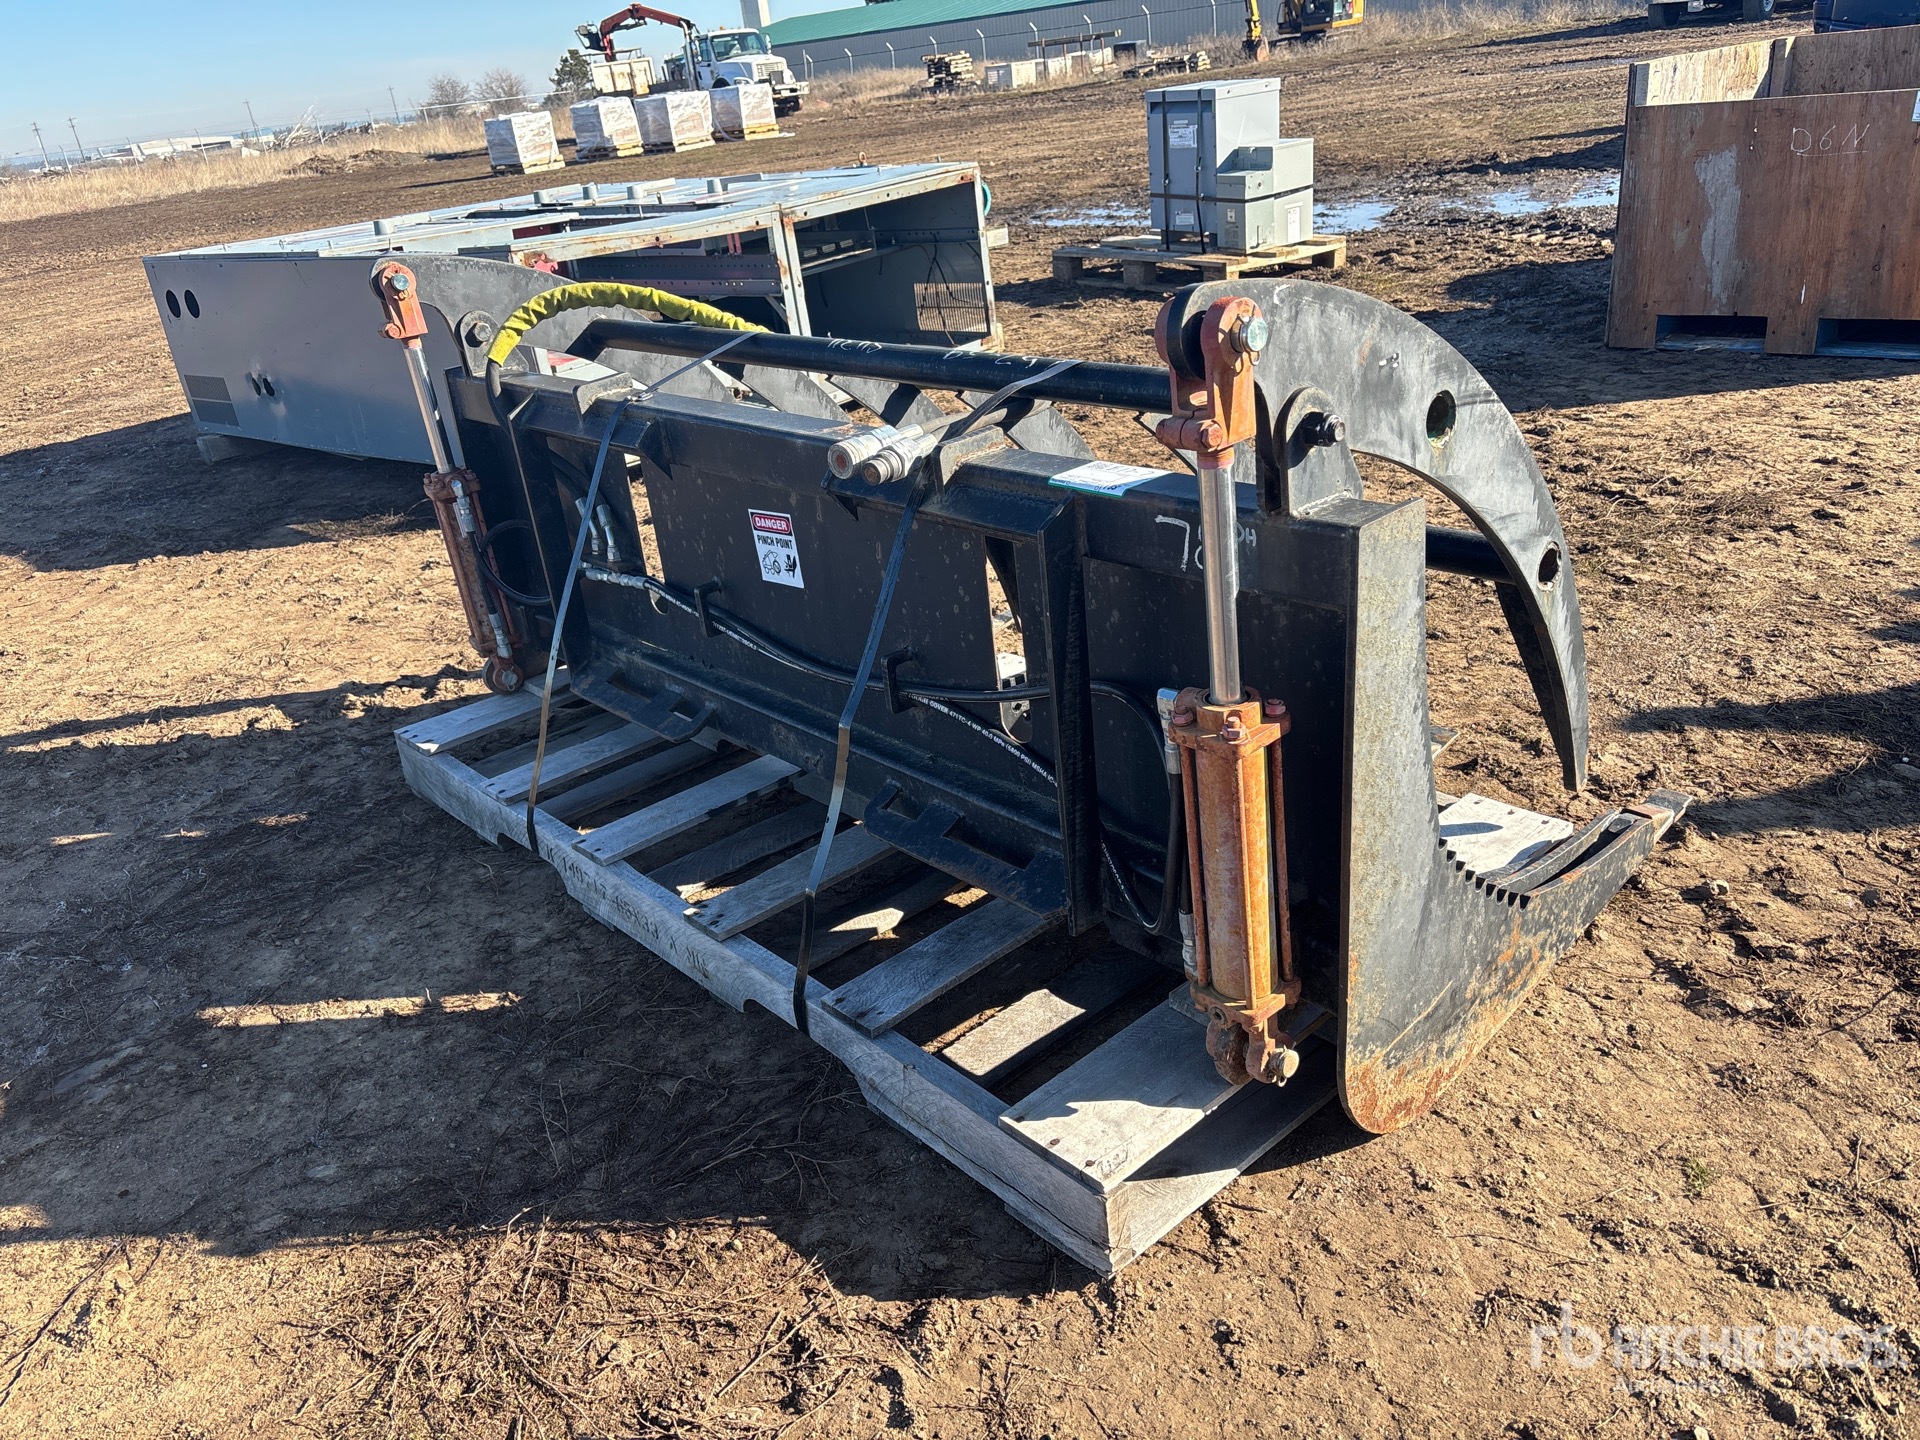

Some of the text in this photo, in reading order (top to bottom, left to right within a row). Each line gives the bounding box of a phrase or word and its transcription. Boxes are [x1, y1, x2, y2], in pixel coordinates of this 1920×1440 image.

[754, 517, 788, 531] DANGER
[757, 534, 793, 550] PINCH POINT
[930, 699, 949, 715] COVER
[949, 711, 971, 727] 471TC-4
[972, 723, 982, 733] WP
[1031, 763, 1047, 779] MSHA
